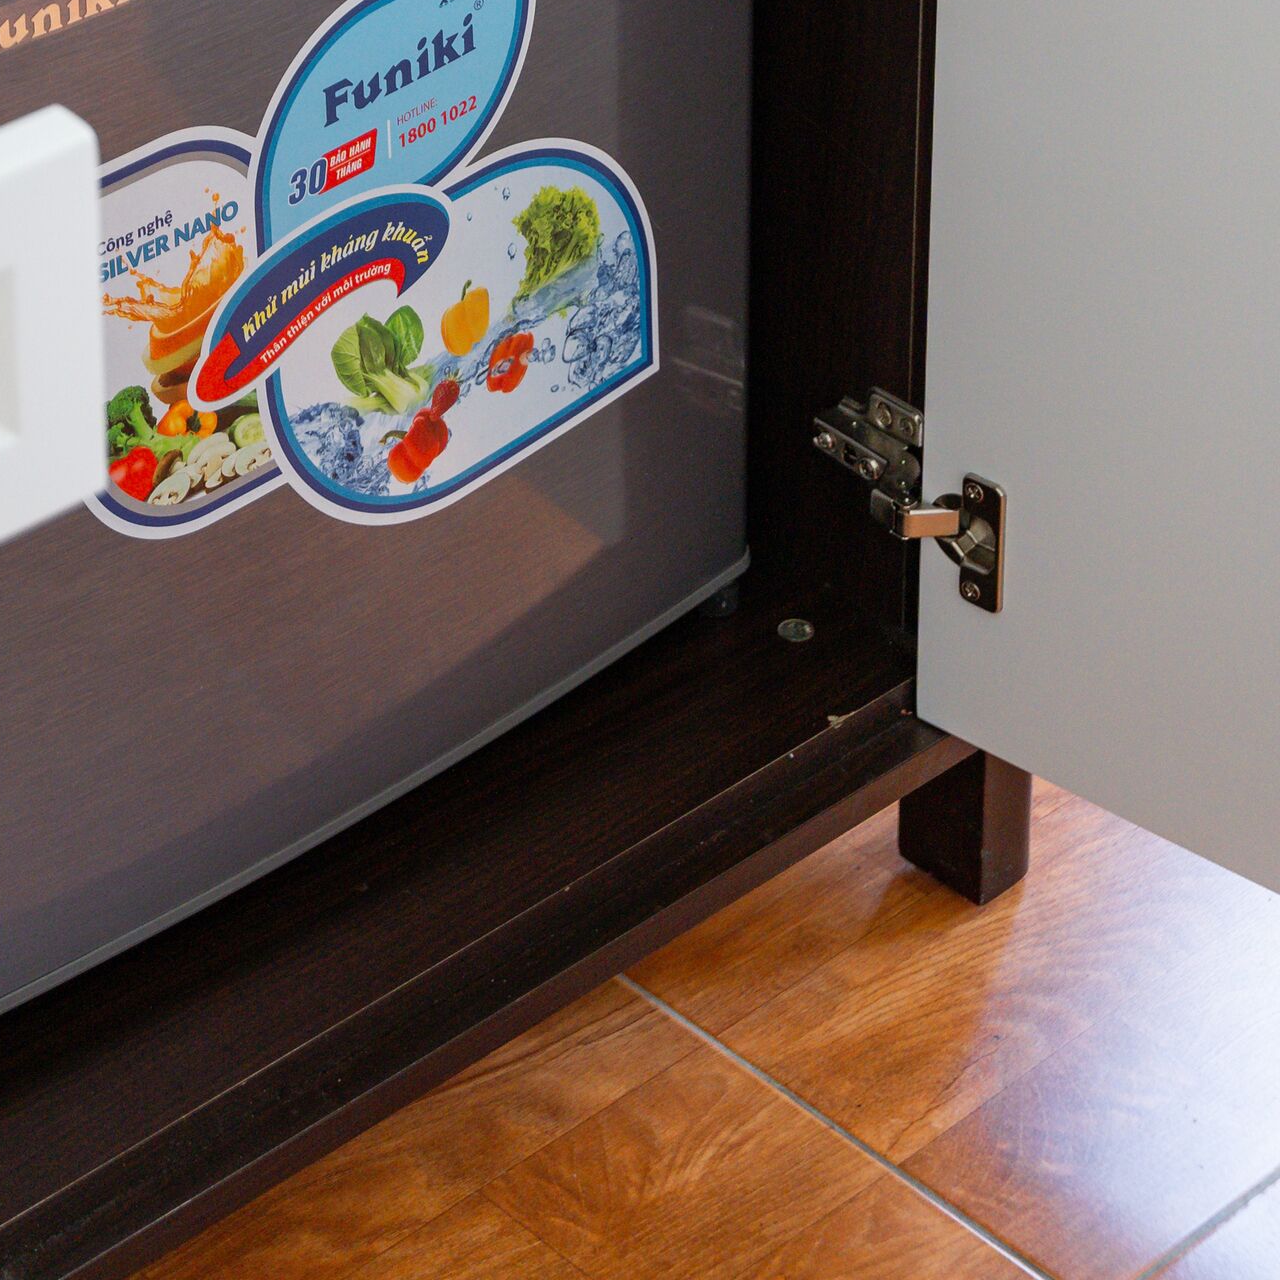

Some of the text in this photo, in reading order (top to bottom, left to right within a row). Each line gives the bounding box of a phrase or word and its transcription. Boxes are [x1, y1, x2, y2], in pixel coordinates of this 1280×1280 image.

[322, 13, 476, 128] Funiki
[396, 97, 438, 126] HOTLINE:
[399, 95, 478, 147] 1800 1022
[330, 137, 371, 167] BẢO HÀNH
[336, 158, 363, 180] THÁNG
[288, 157, 327, 205] 30
[98, 210, 173, 257] Công nghệ
[99, 200, 239, 283] SILVER NANO
[281, 260, 317, 305] mùi
[320, 228, 380, 273] kháng
[260, 262, 391, 364] Thân thiện với môi trường
